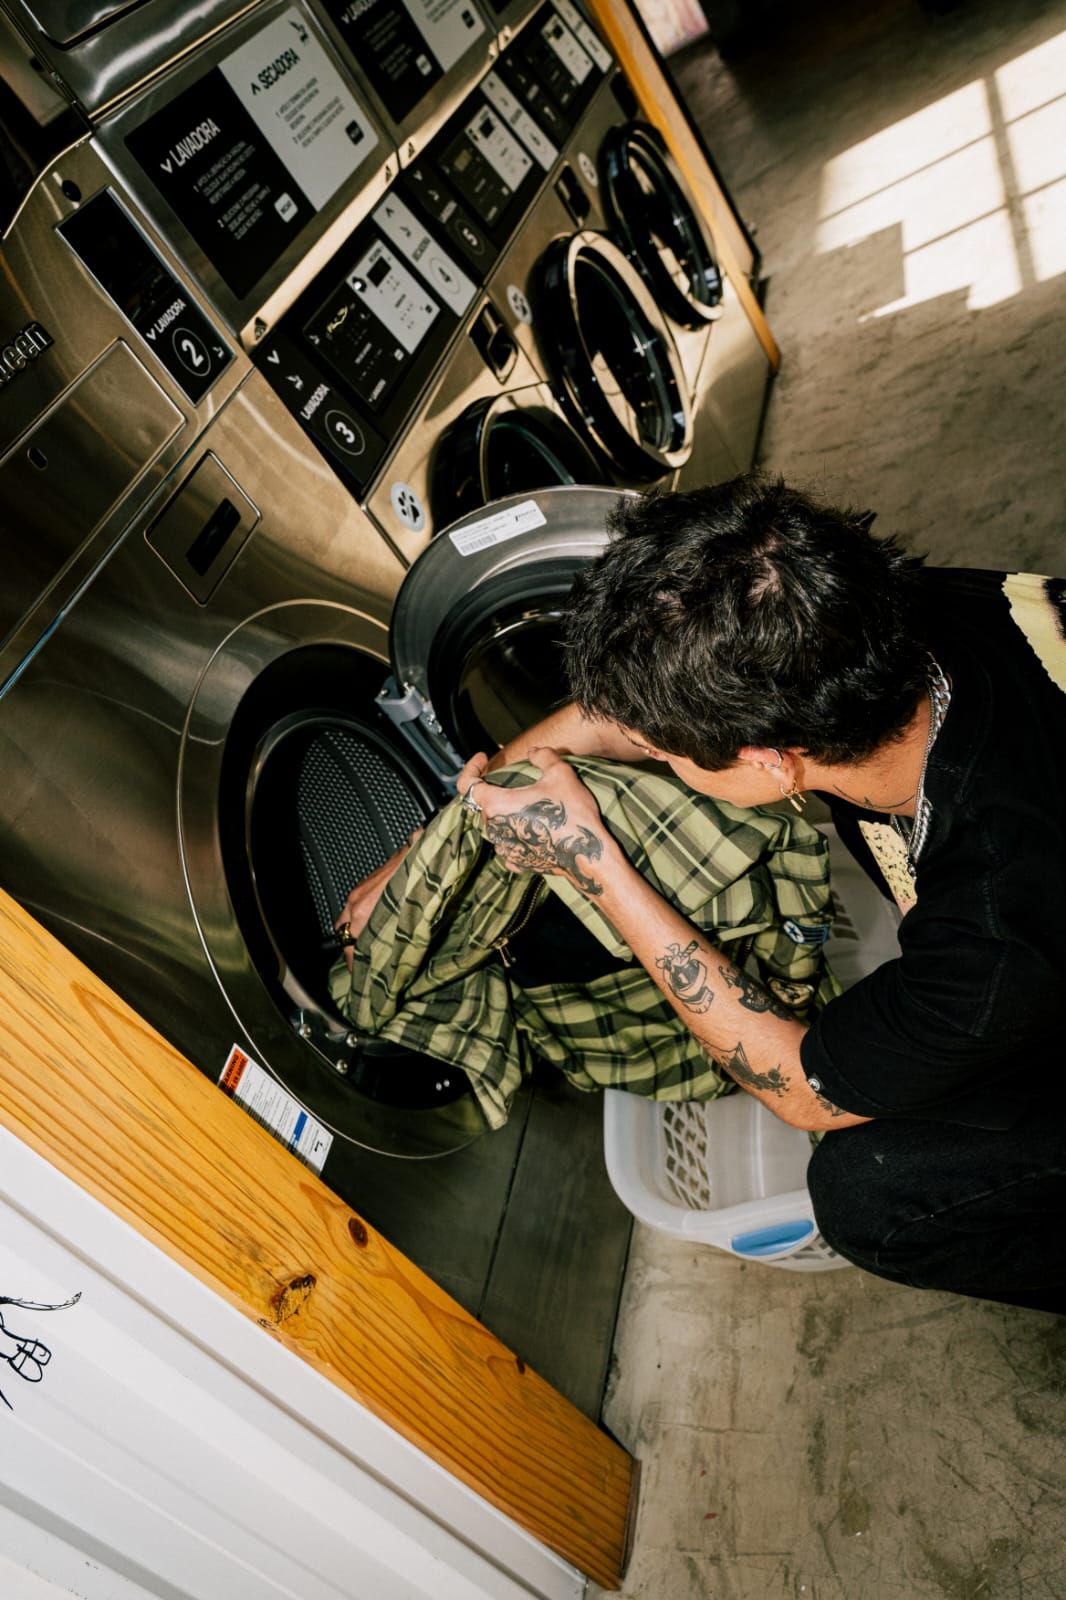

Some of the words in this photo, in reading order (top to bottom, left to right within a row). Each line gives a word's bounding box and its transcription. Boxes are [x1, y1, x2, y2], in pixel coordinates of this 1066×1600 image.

[258, 48, 301, 89] SECADORA
[169, 118, 221, 167] LAVADORA
[462, 228, 478, 247] 5
[154, 298, 187, 333] LAVADORA
[181, 339, 204, 367] 2
[300, 384, 330, 420] LAVADORA
[335, 421, 355, 444] 3
